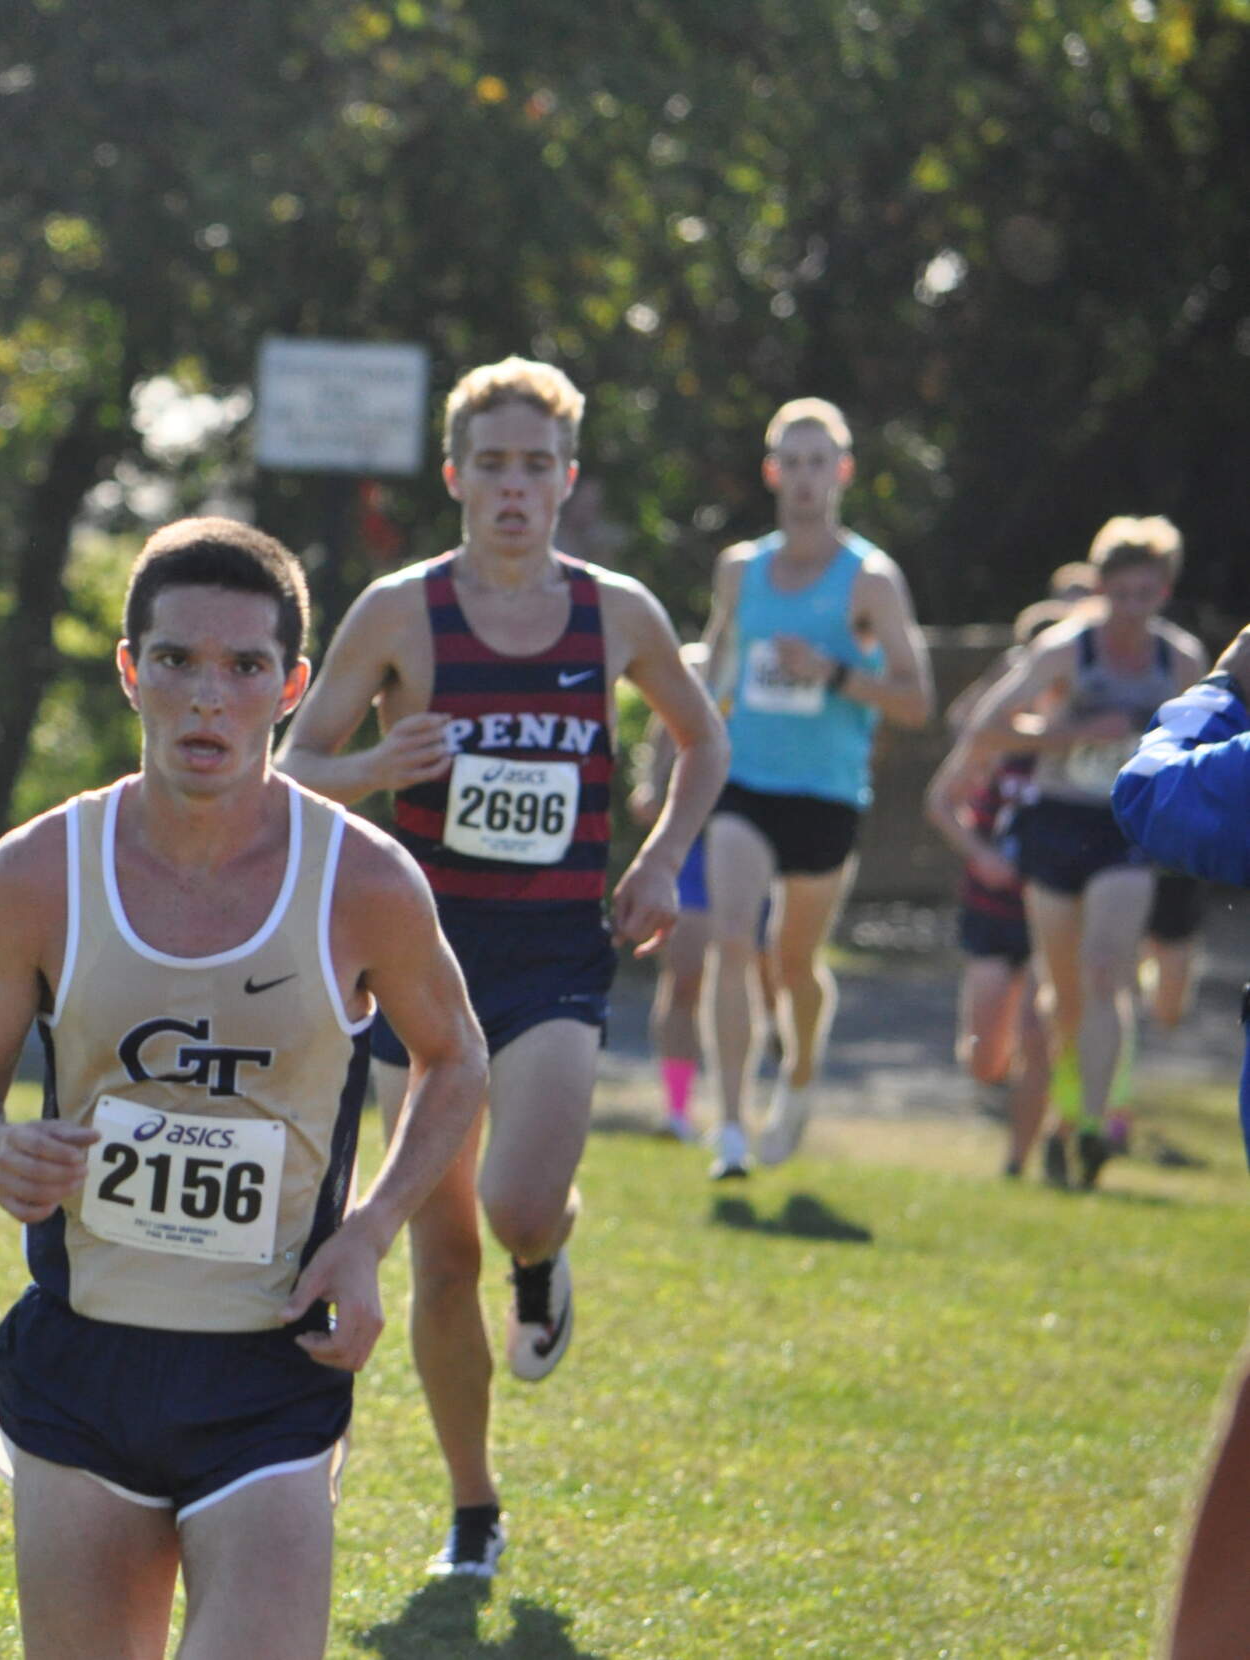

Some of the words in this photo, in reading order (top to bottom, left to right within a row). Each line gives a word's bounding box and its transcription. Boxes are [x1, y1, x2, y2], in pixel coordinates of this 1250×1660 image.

[442, 712, 600, 755] PENN
[456, 785, 566, 836] 2696
[166, 1124, 236, 1149] asics
[97, 1142, 266, 1225] 2156
